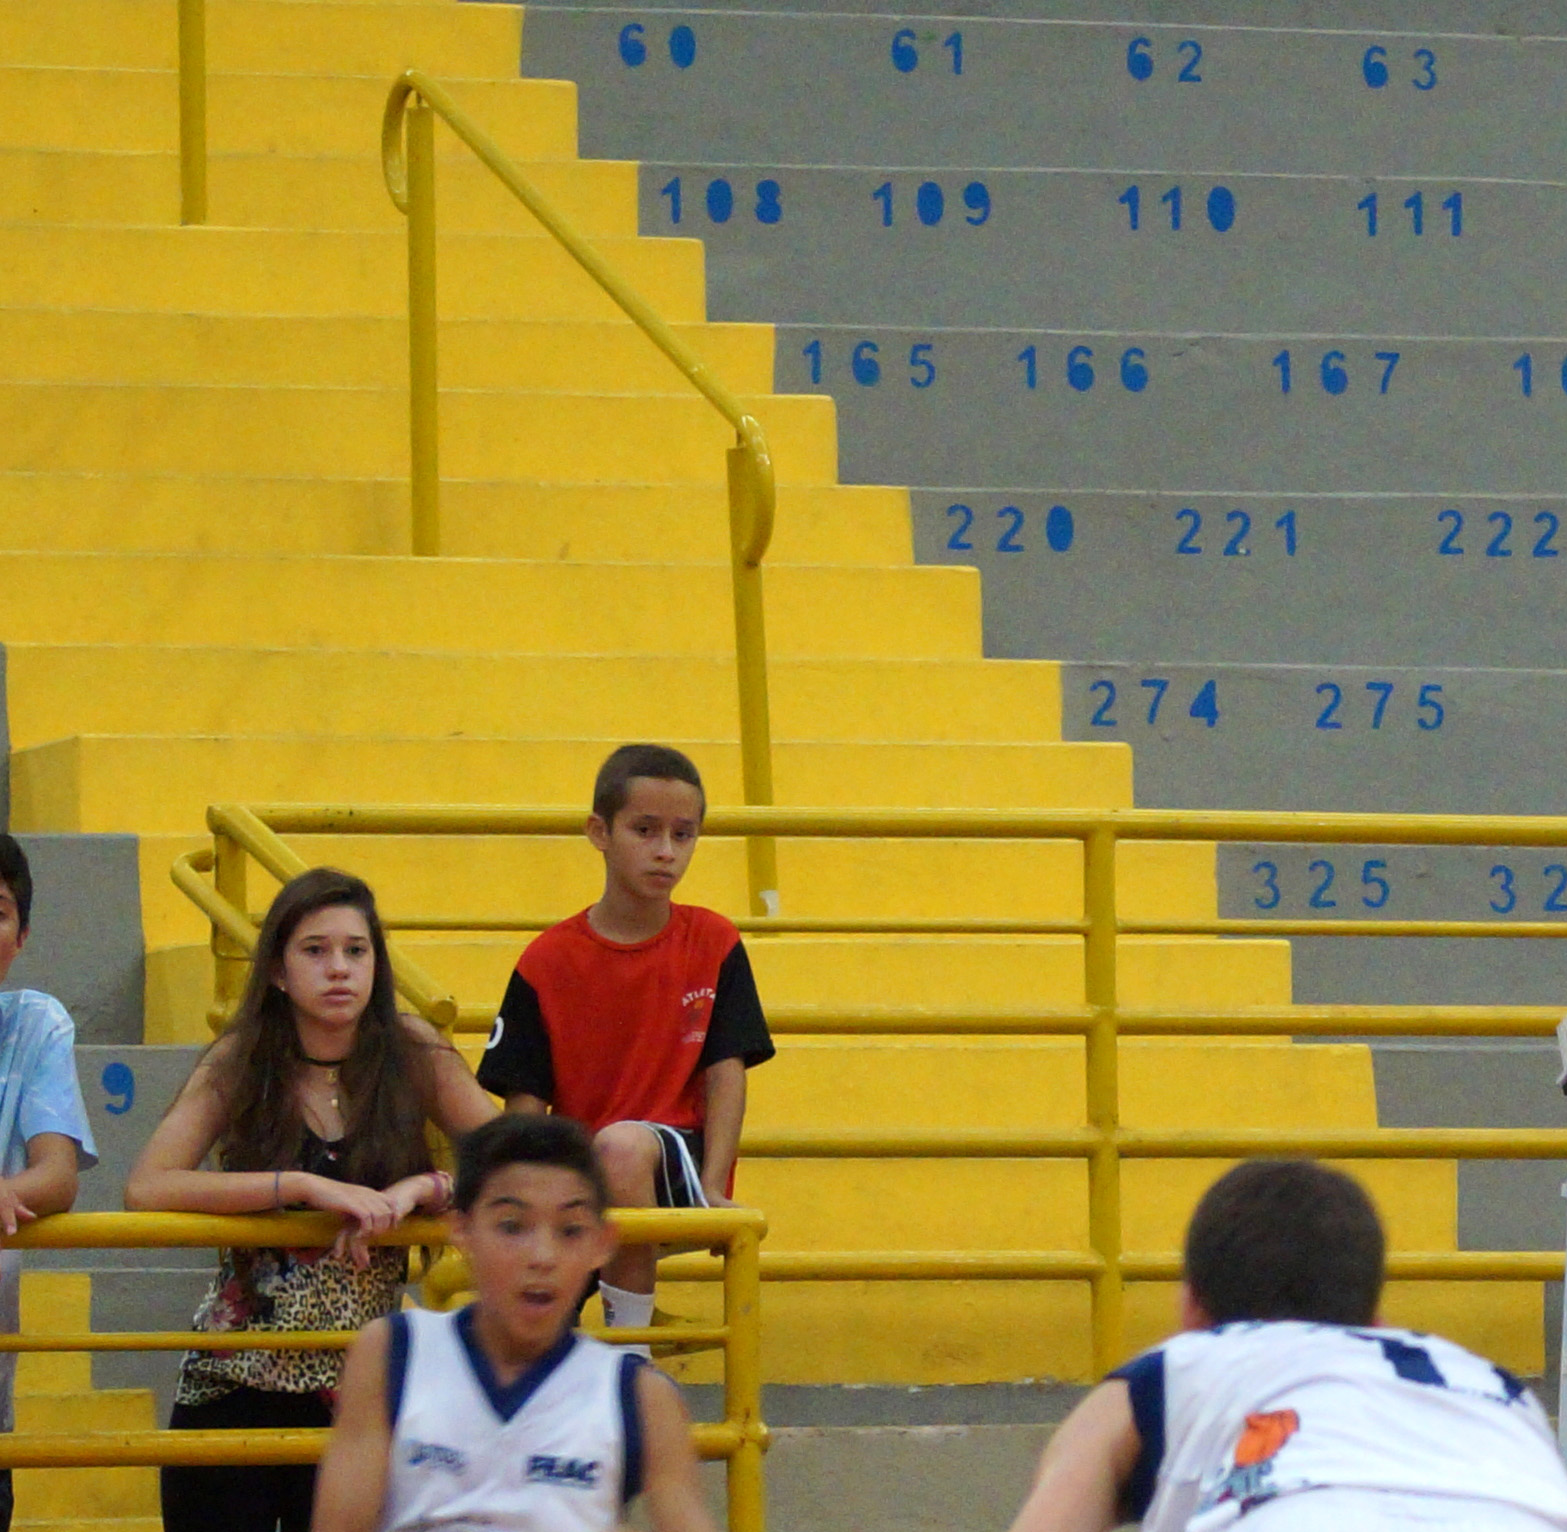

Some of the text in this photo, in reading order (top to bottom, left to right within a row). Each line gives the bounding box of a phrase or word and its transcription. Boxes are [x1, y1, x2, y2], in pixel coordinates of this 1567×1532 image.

[617, 22, 698, 69] 60
[889, 28, 964, 75] 61
[1125, 36, 1204, 83] 62
[1360, 45, 1438, 91] 63
[660, 177, 784, 225] 108
[871, 181, 992, 227] 109
[1117, 185, 1238, 234] 110
[1356, 191, 1464, 237] 111
[802, 340, 937, 388] 165
[1016, 345, 1150, 393] 166
[1271, 349, 1402, 396] 167
[946, 504, 1076, 553] 220
[1174, 507, 1298, 557] 221
[1436, 509, 1561, 559] 222
[1089, 678, 1221, 728] 274
[1314, 681, 1446, 731] 275
[1252, 859, 1392, 909] 325
